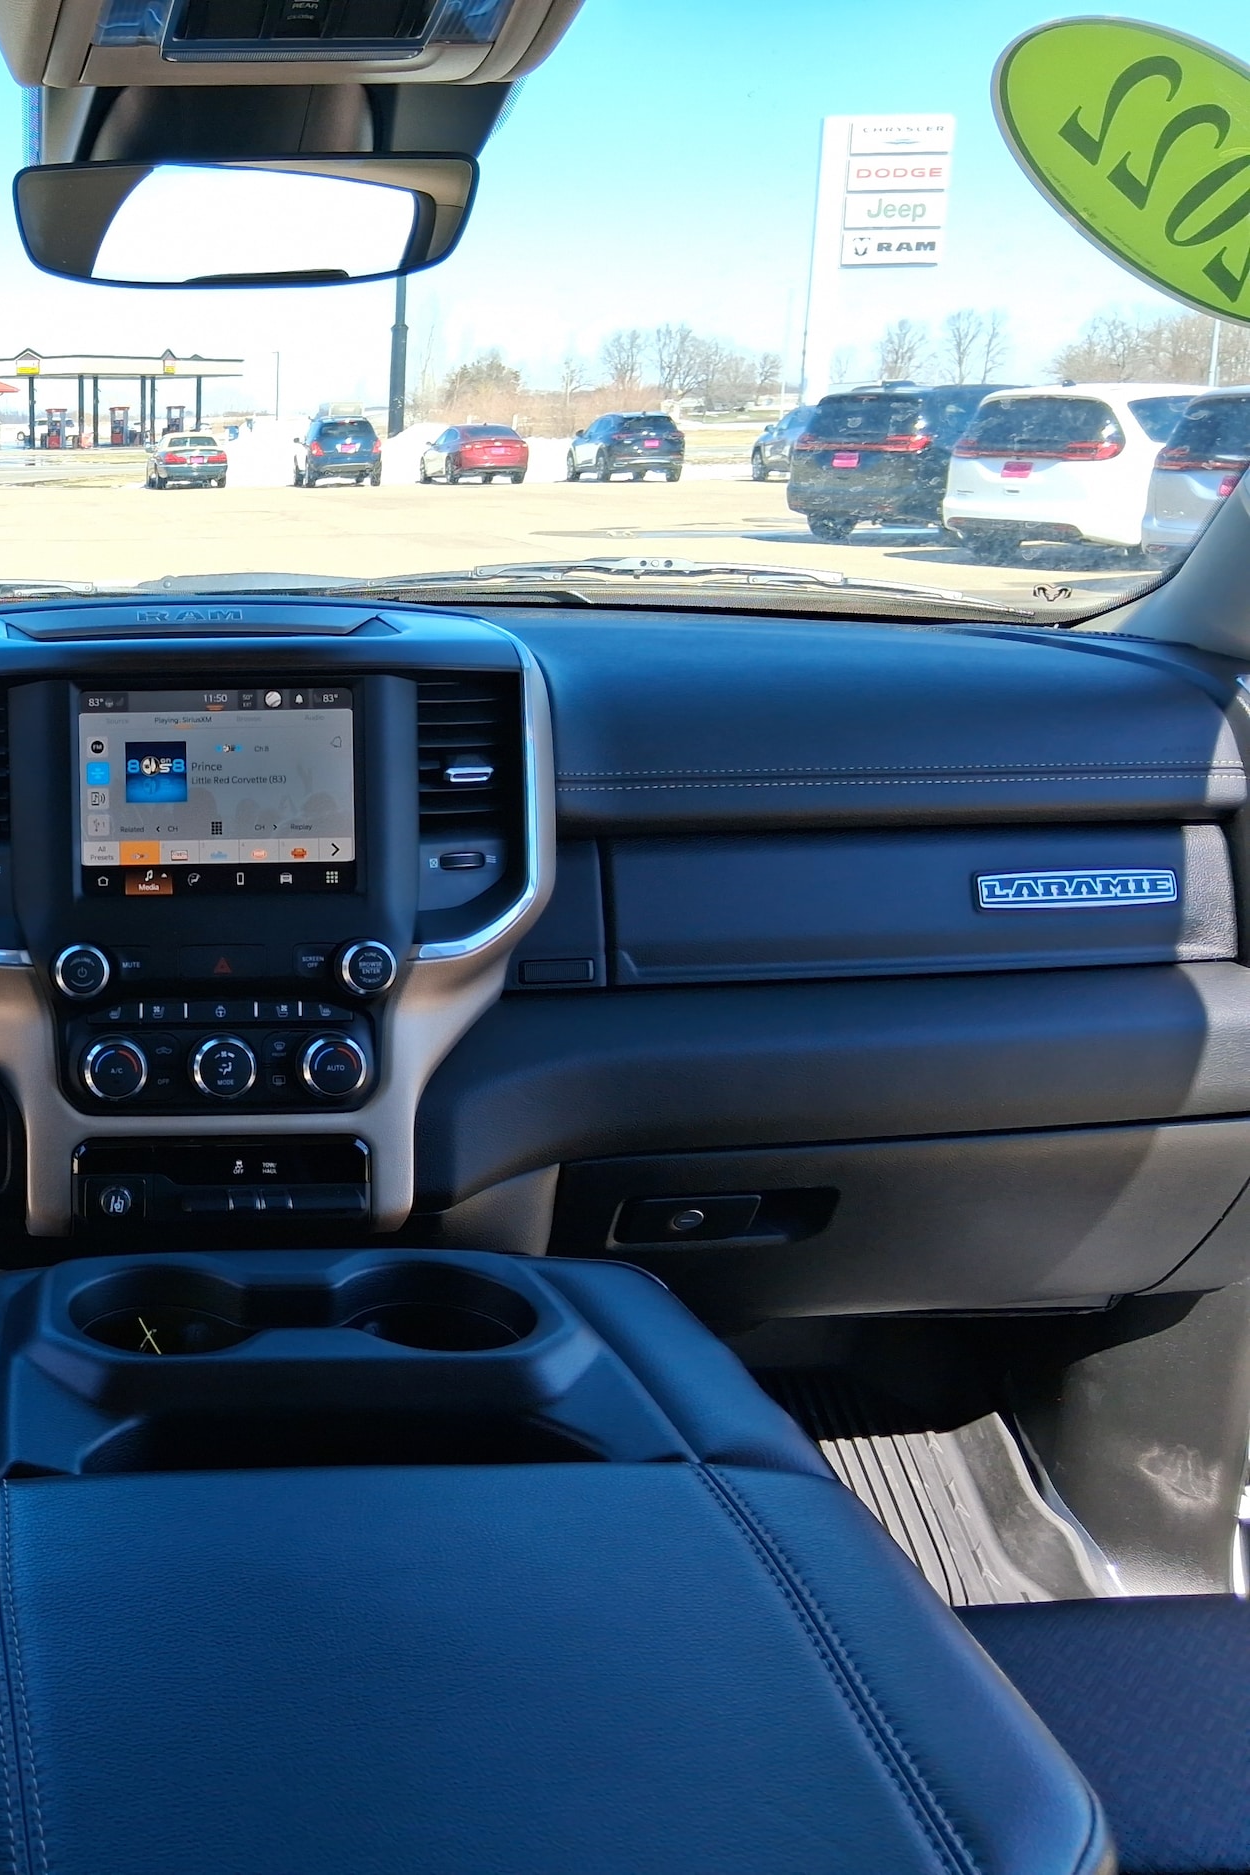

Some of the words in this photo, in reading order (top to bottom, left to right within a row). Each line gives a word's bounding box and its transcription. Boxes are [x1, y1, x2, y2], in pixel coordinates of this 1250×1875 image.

[291, 2, 319, 10] REAR
[856, 167, 943, 179] DODGE
[867, 198, 927, 223] Jeep
[876, 241, 937, 252] RAM
[136, 609, 244, 622] RAM
[203, 693, 228, 703] 11:50
[182, 716, 212, 724] SiriusXM
[191, 762, 223, 772] Prince
[191, 776, 211, 785] Little
[213, 776, 230, 784] Red
[231, 775, 268, 785] Corvette
[269, 775, 287, 785] (83)
[290, 823, 313, 832] Replay
[90, 854, 114, 862] Presets
[138, 883, 160, 892] Media
[981, 874, 1174, 902] LARAMIE
[121, 961, 141, 969] MUTE
[358, 961, 383, 969] BROWSE
[110, 1067, 124, 1075] A/C
[326, 1064, 346, 1072] AUTO
[157, 1078, 170, 1086] OFF
